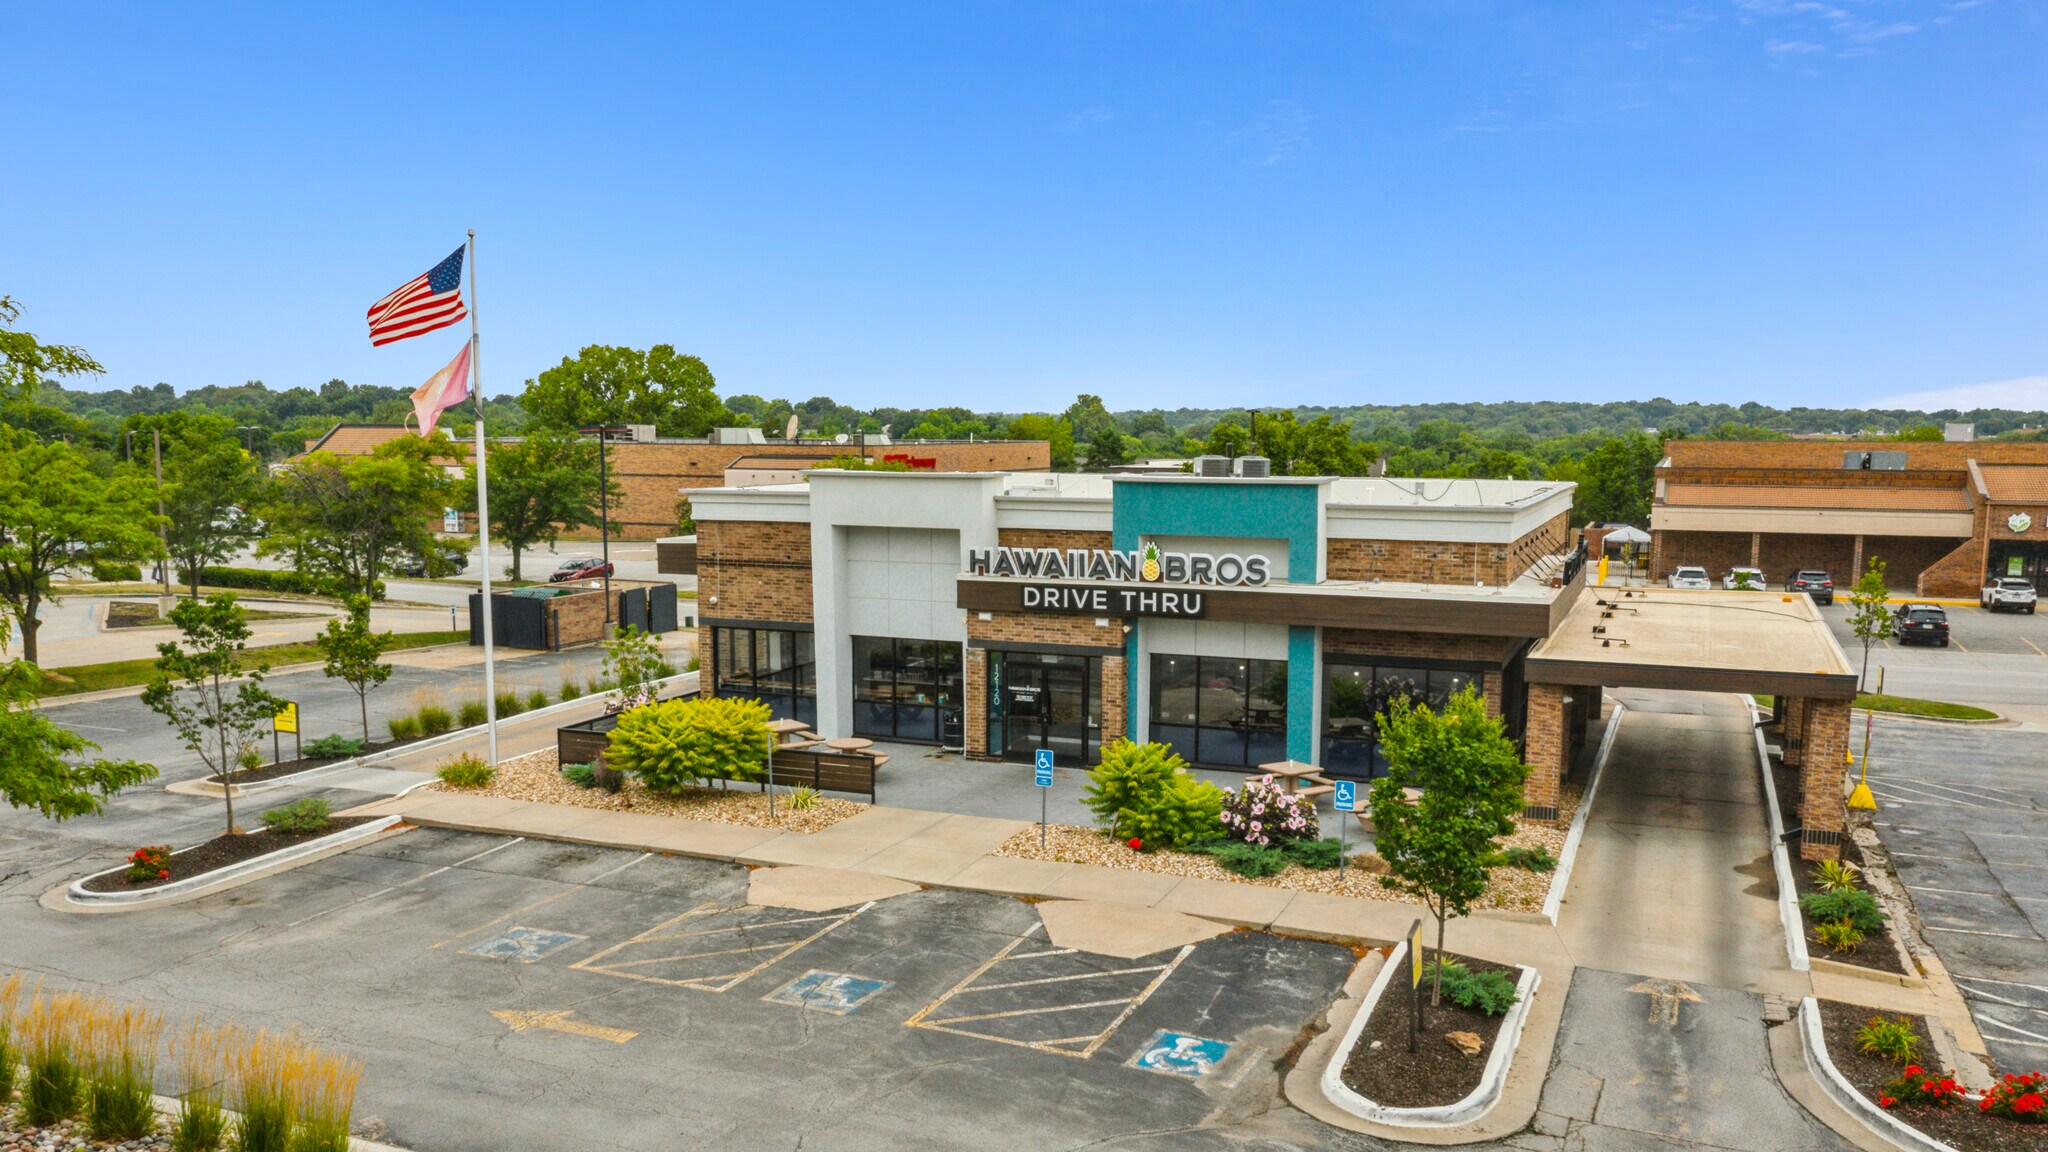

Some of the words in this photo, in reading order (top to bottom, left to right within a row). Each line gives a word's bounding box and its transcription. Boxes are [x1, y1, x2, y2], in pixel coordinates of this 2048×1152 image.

[969, 547, 1139, 581] HAWAIIAN
[1164, 552, 1270, 587] BROS
[1023, 586, 1108, 610] DRIVE
[1120, 591, 1201, 614] THRU
